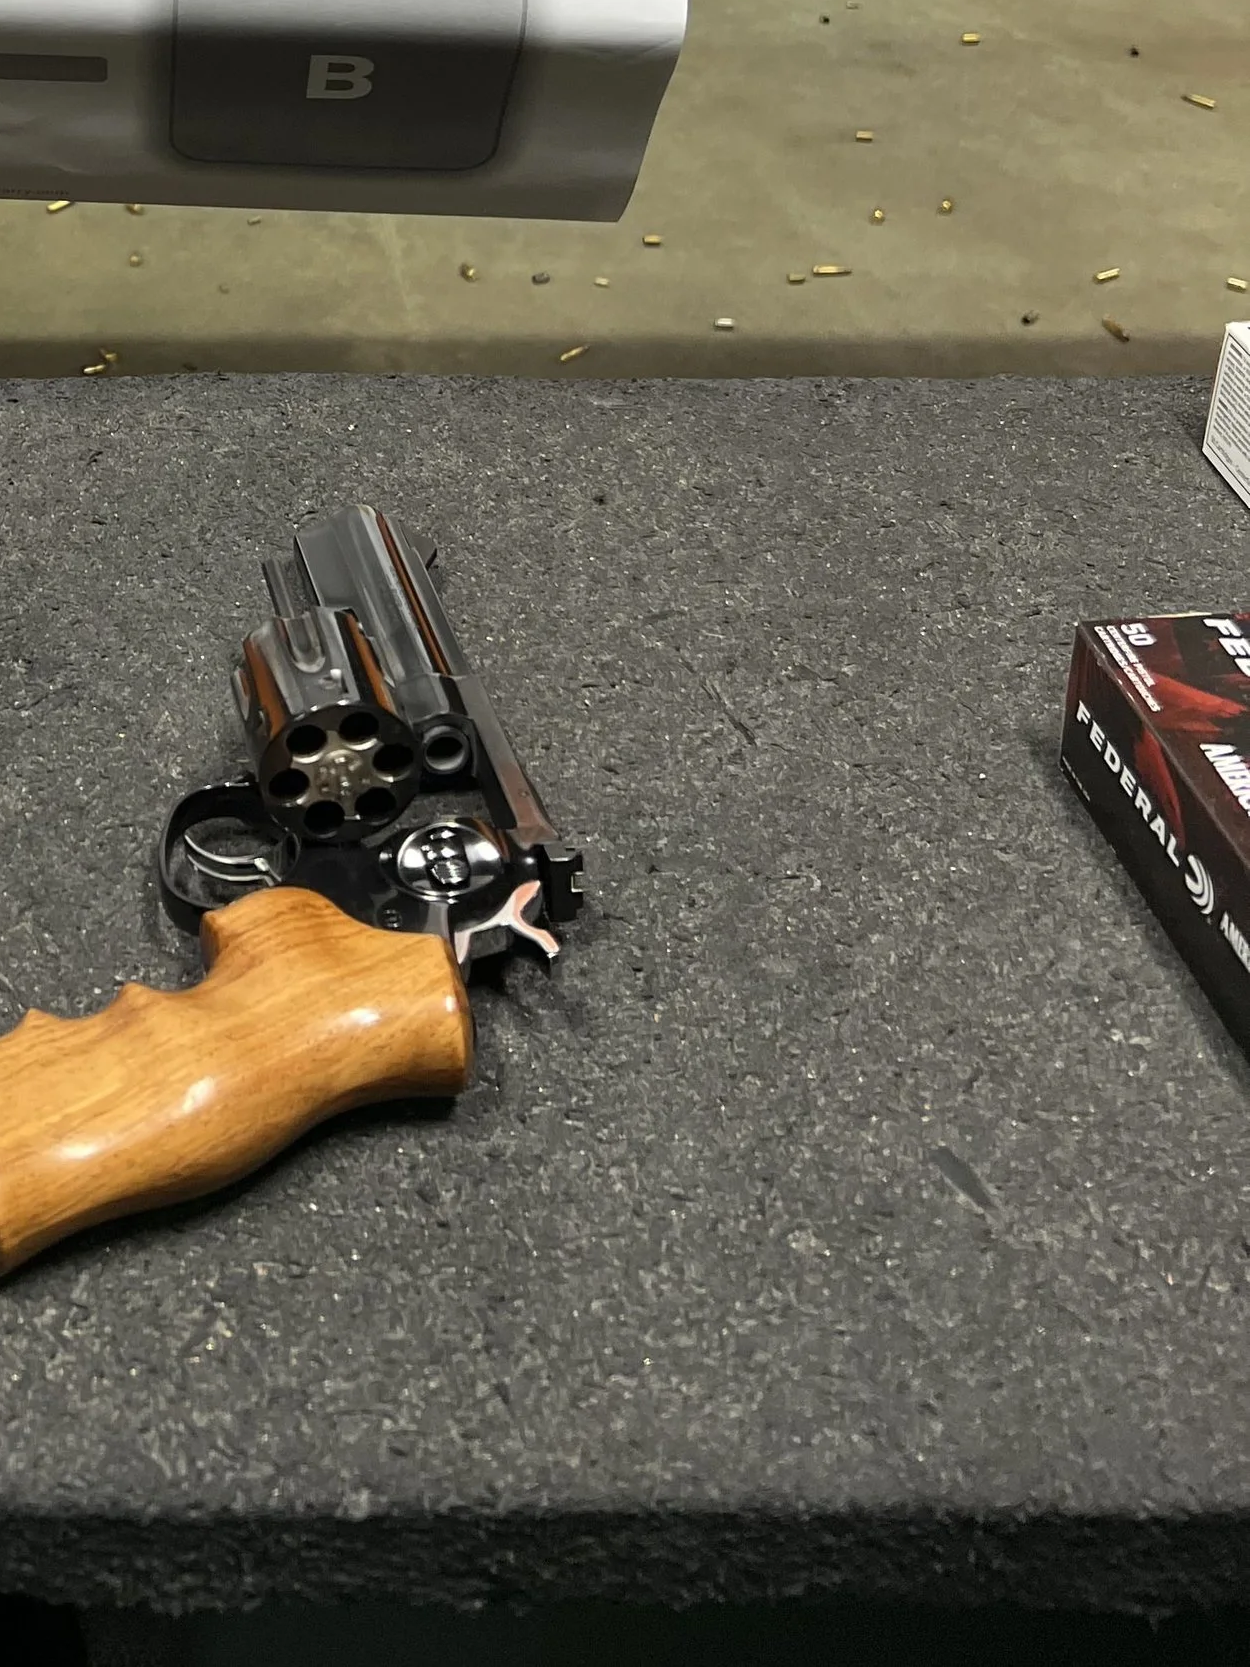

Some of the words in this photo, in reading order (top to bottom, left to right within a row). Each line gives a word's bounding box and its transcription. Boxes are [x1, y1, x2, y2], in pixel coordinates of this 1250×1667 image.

[306, 54, 374, 99] B
[1121, 622, 1157, 646] 50
[1076, 700, 1180, 867] FEDERAL
